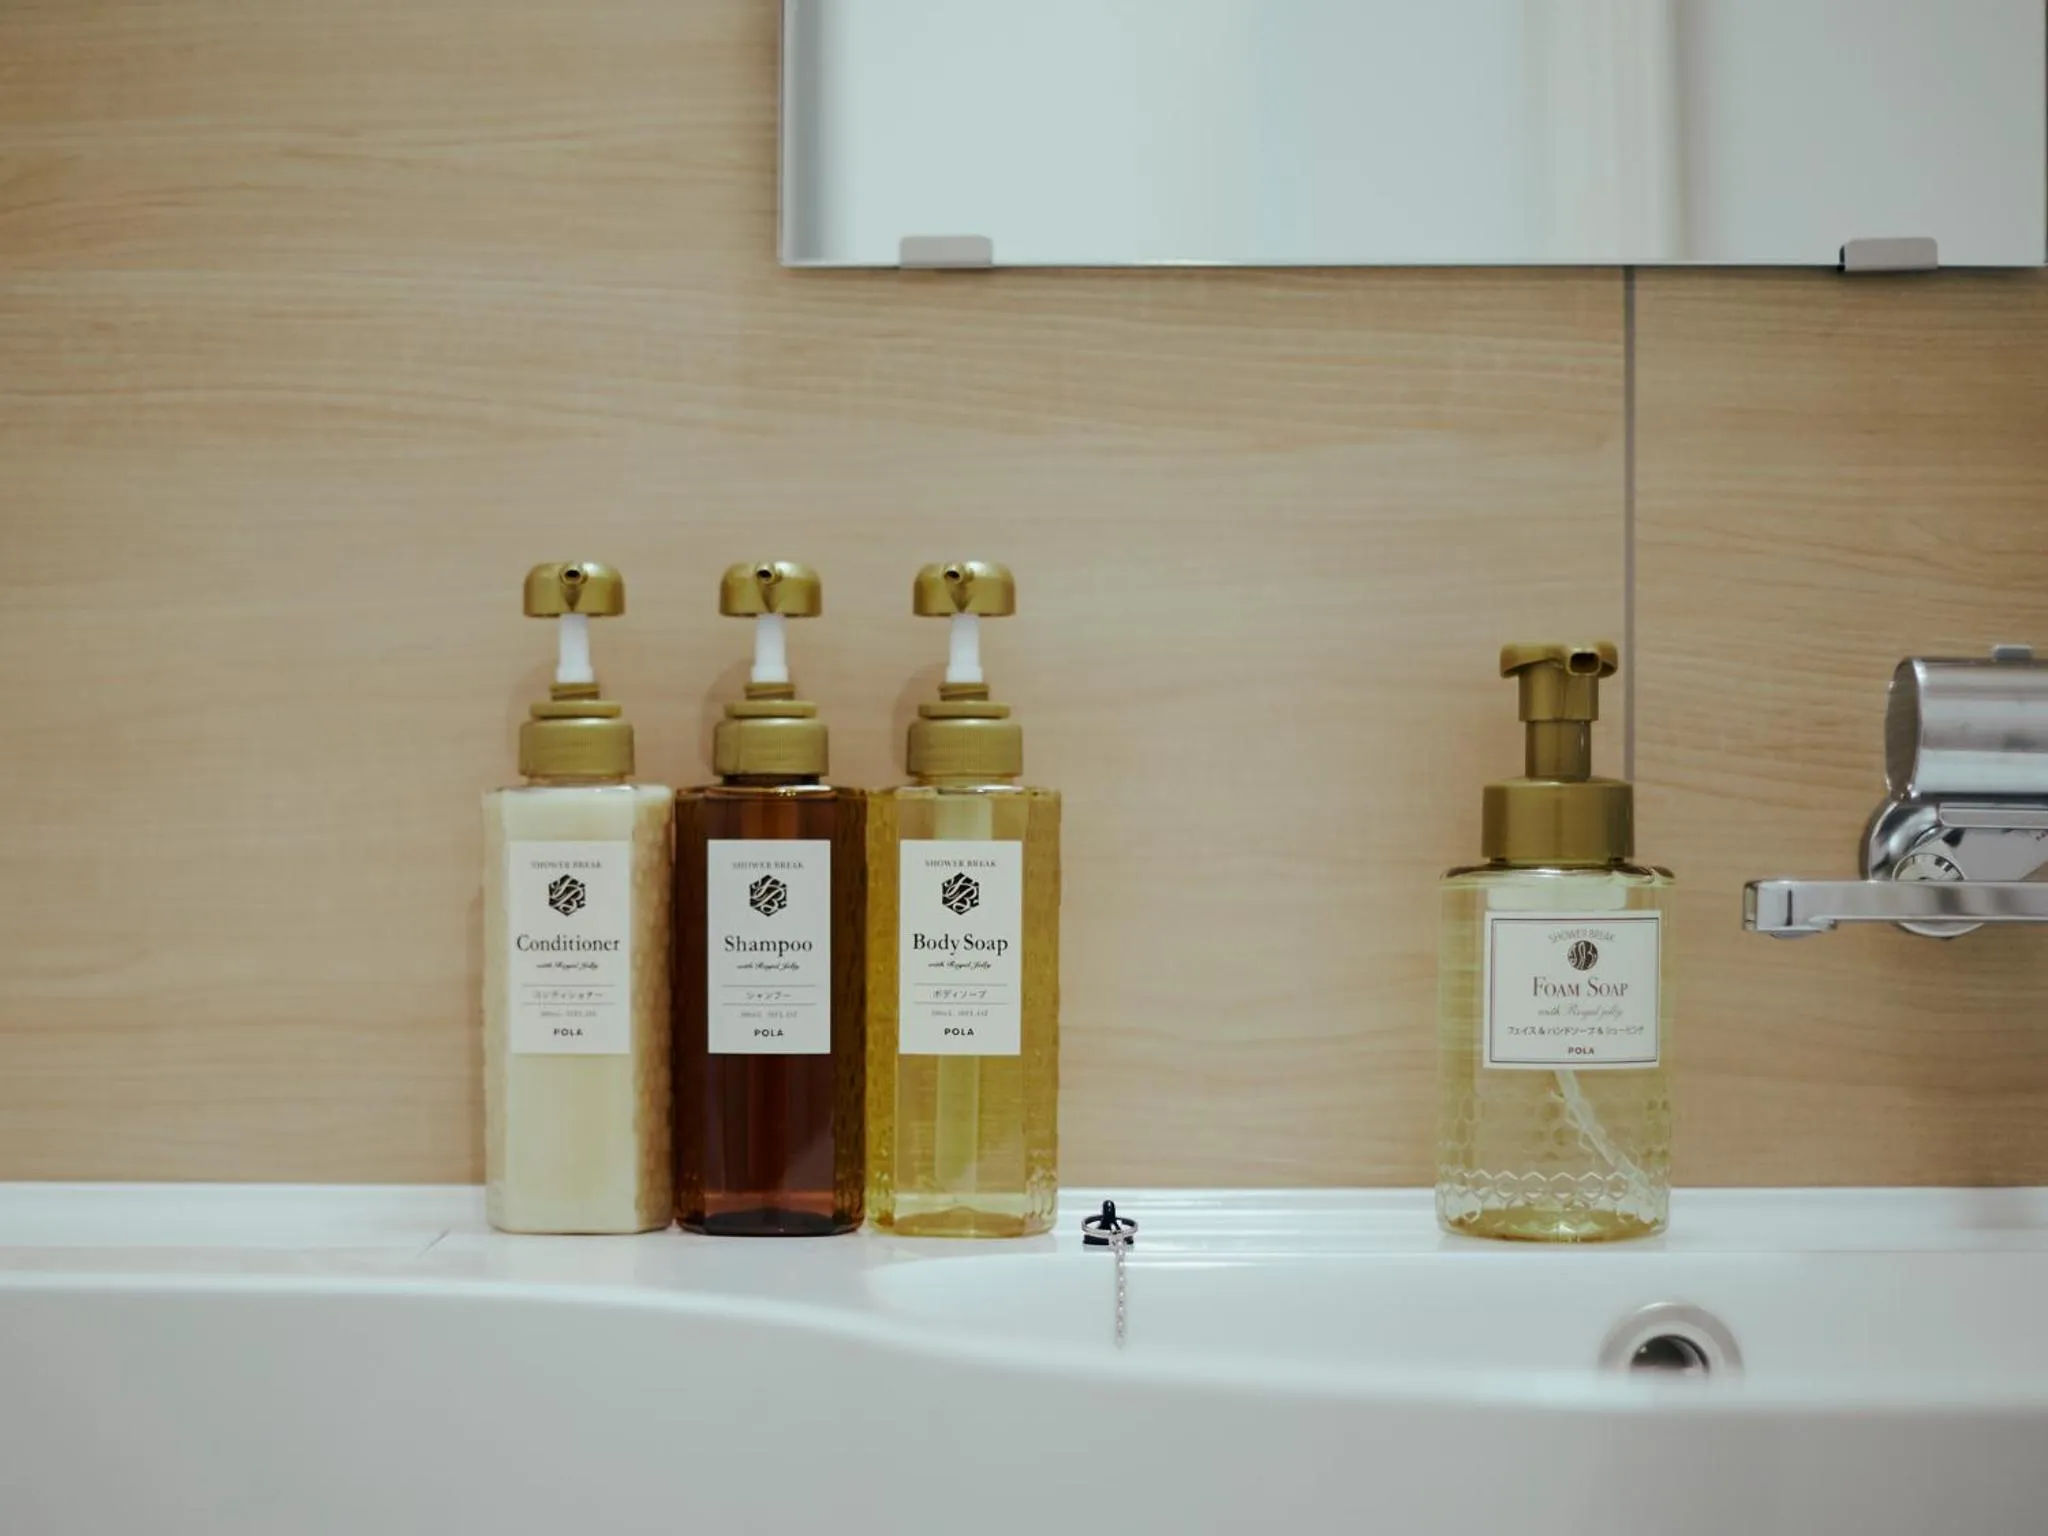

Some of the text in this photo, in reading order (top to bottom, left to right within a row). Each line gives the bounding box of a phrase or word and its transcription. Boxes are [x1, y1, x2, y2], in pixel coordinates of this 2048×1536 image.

[516, 933, 621, 952] Conditioner
[724, 935, 813, 957] Shampoo
[913, 933, 1009, 956] Body Soap
[553, 1027, 584, 1037] POLA
[754, 1028, 784, 1038] POLA
[944, 1027, 975, 1036] POLA
[1567, 1046, 1595, 1055] POLA
